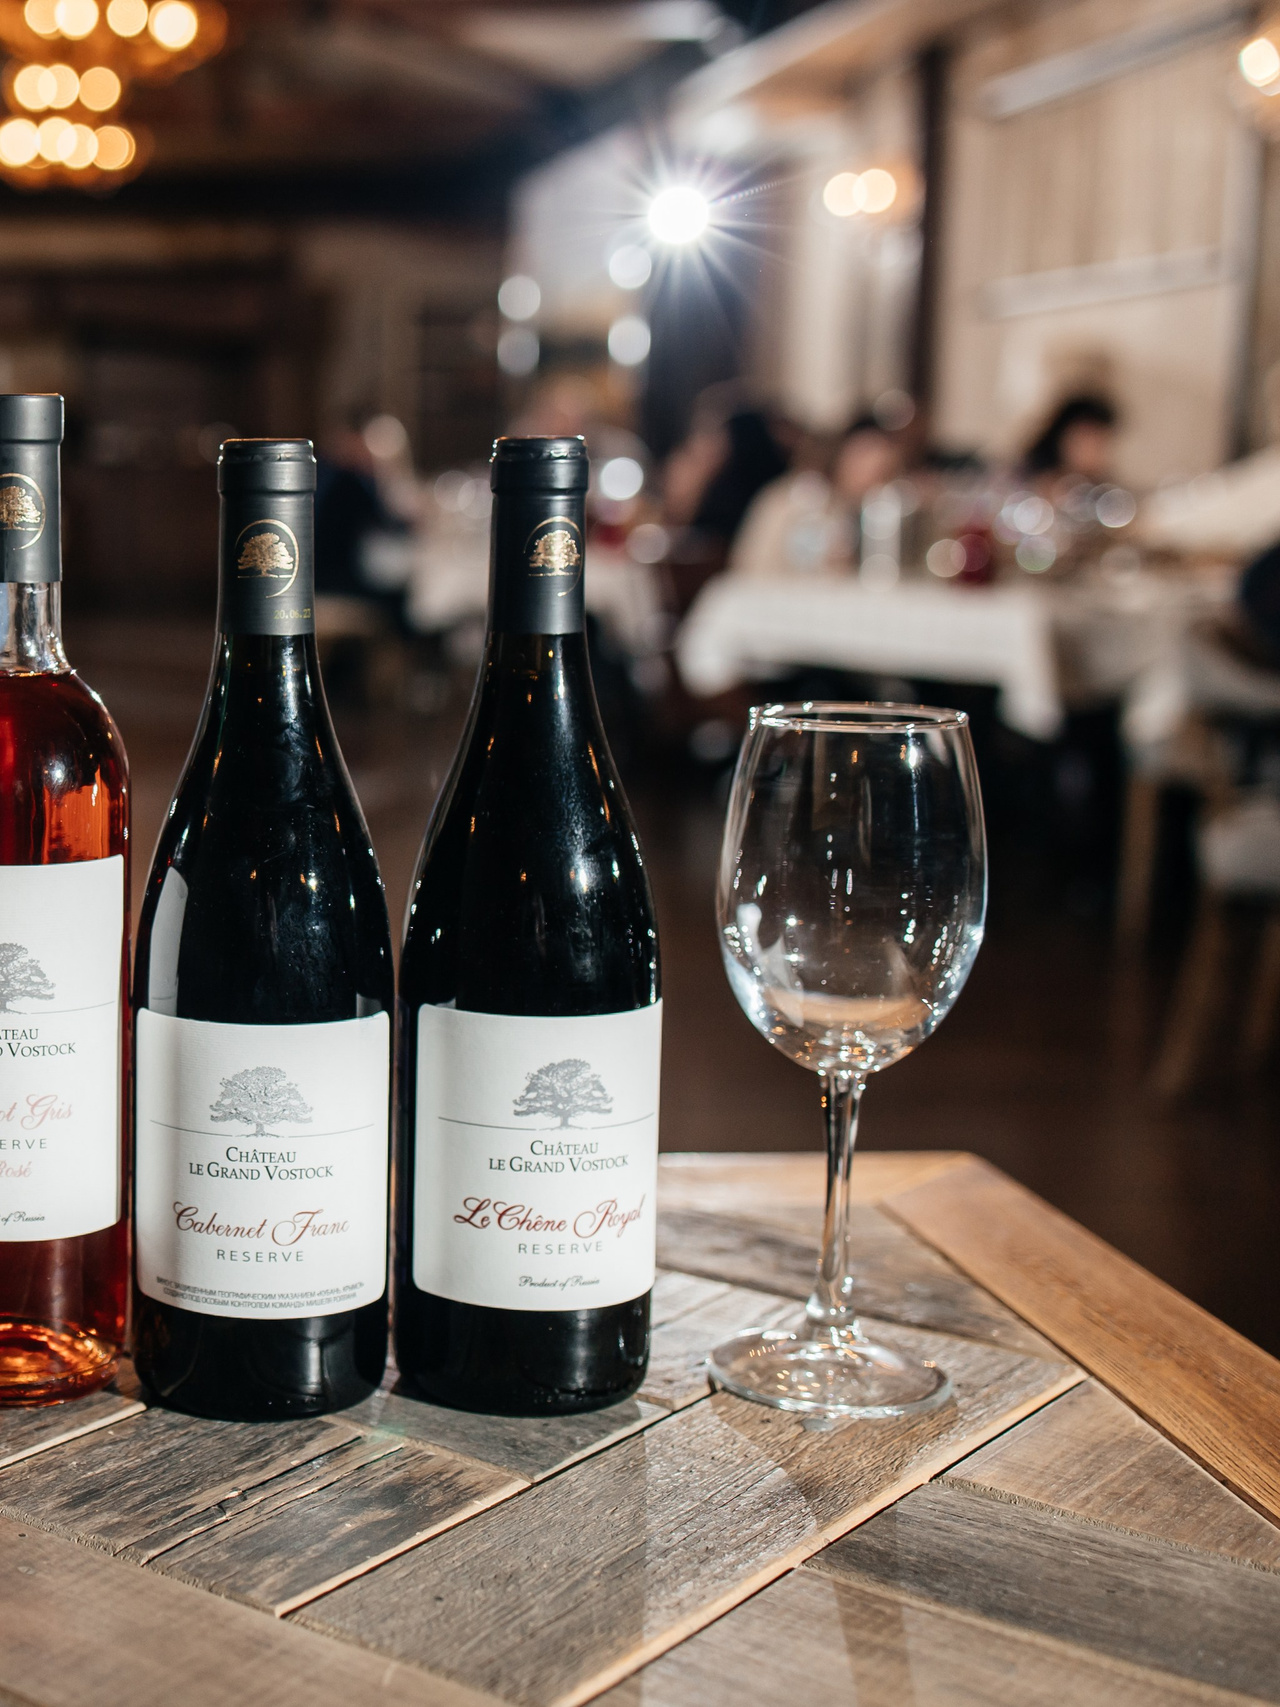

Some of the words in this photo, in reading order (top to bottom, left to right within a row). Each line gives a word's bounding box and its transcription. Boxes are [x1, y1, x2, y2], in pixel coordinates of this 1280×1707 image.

[6, 1042, 76, 1057] VOSTOCK
[20, 1093, 73, 1130] Gris
[226, 1146, 297, 1164] CHÂTEAU
[530, 1140, 599, 1155] CHÂTEAU
[189, 1162, 204, 1176] LE
[207, 1162, 261, 1181] GRAND
[264, 1165, 334, 1181] VOSTOCK
[489, 1158, 505, 1171] LE
[509, 1156, 565, 1173] GRAND
[569, 1155, 629, 1173] VOSTOCK
[1, 1212, 12, 1226] of
[13, 1210, 45, 1222] Russia
[173, 1201, 268, 1239] Cabernet
[271, 1209, 350, 1247] Franc
[453, 1197, 491, 1229] Le
[493, 1201, 568, 1232] Chêne
[573, 1193, 646, 1239] Royal
[217, 1249, 305, 1263] RESERVE
[518, 1241, 603, 1255] RESERVE
[519, 1275, 558, 1288] Product
[558, 1279, 569, 1291] of
[570, 1275, 600, 1287] Russia
